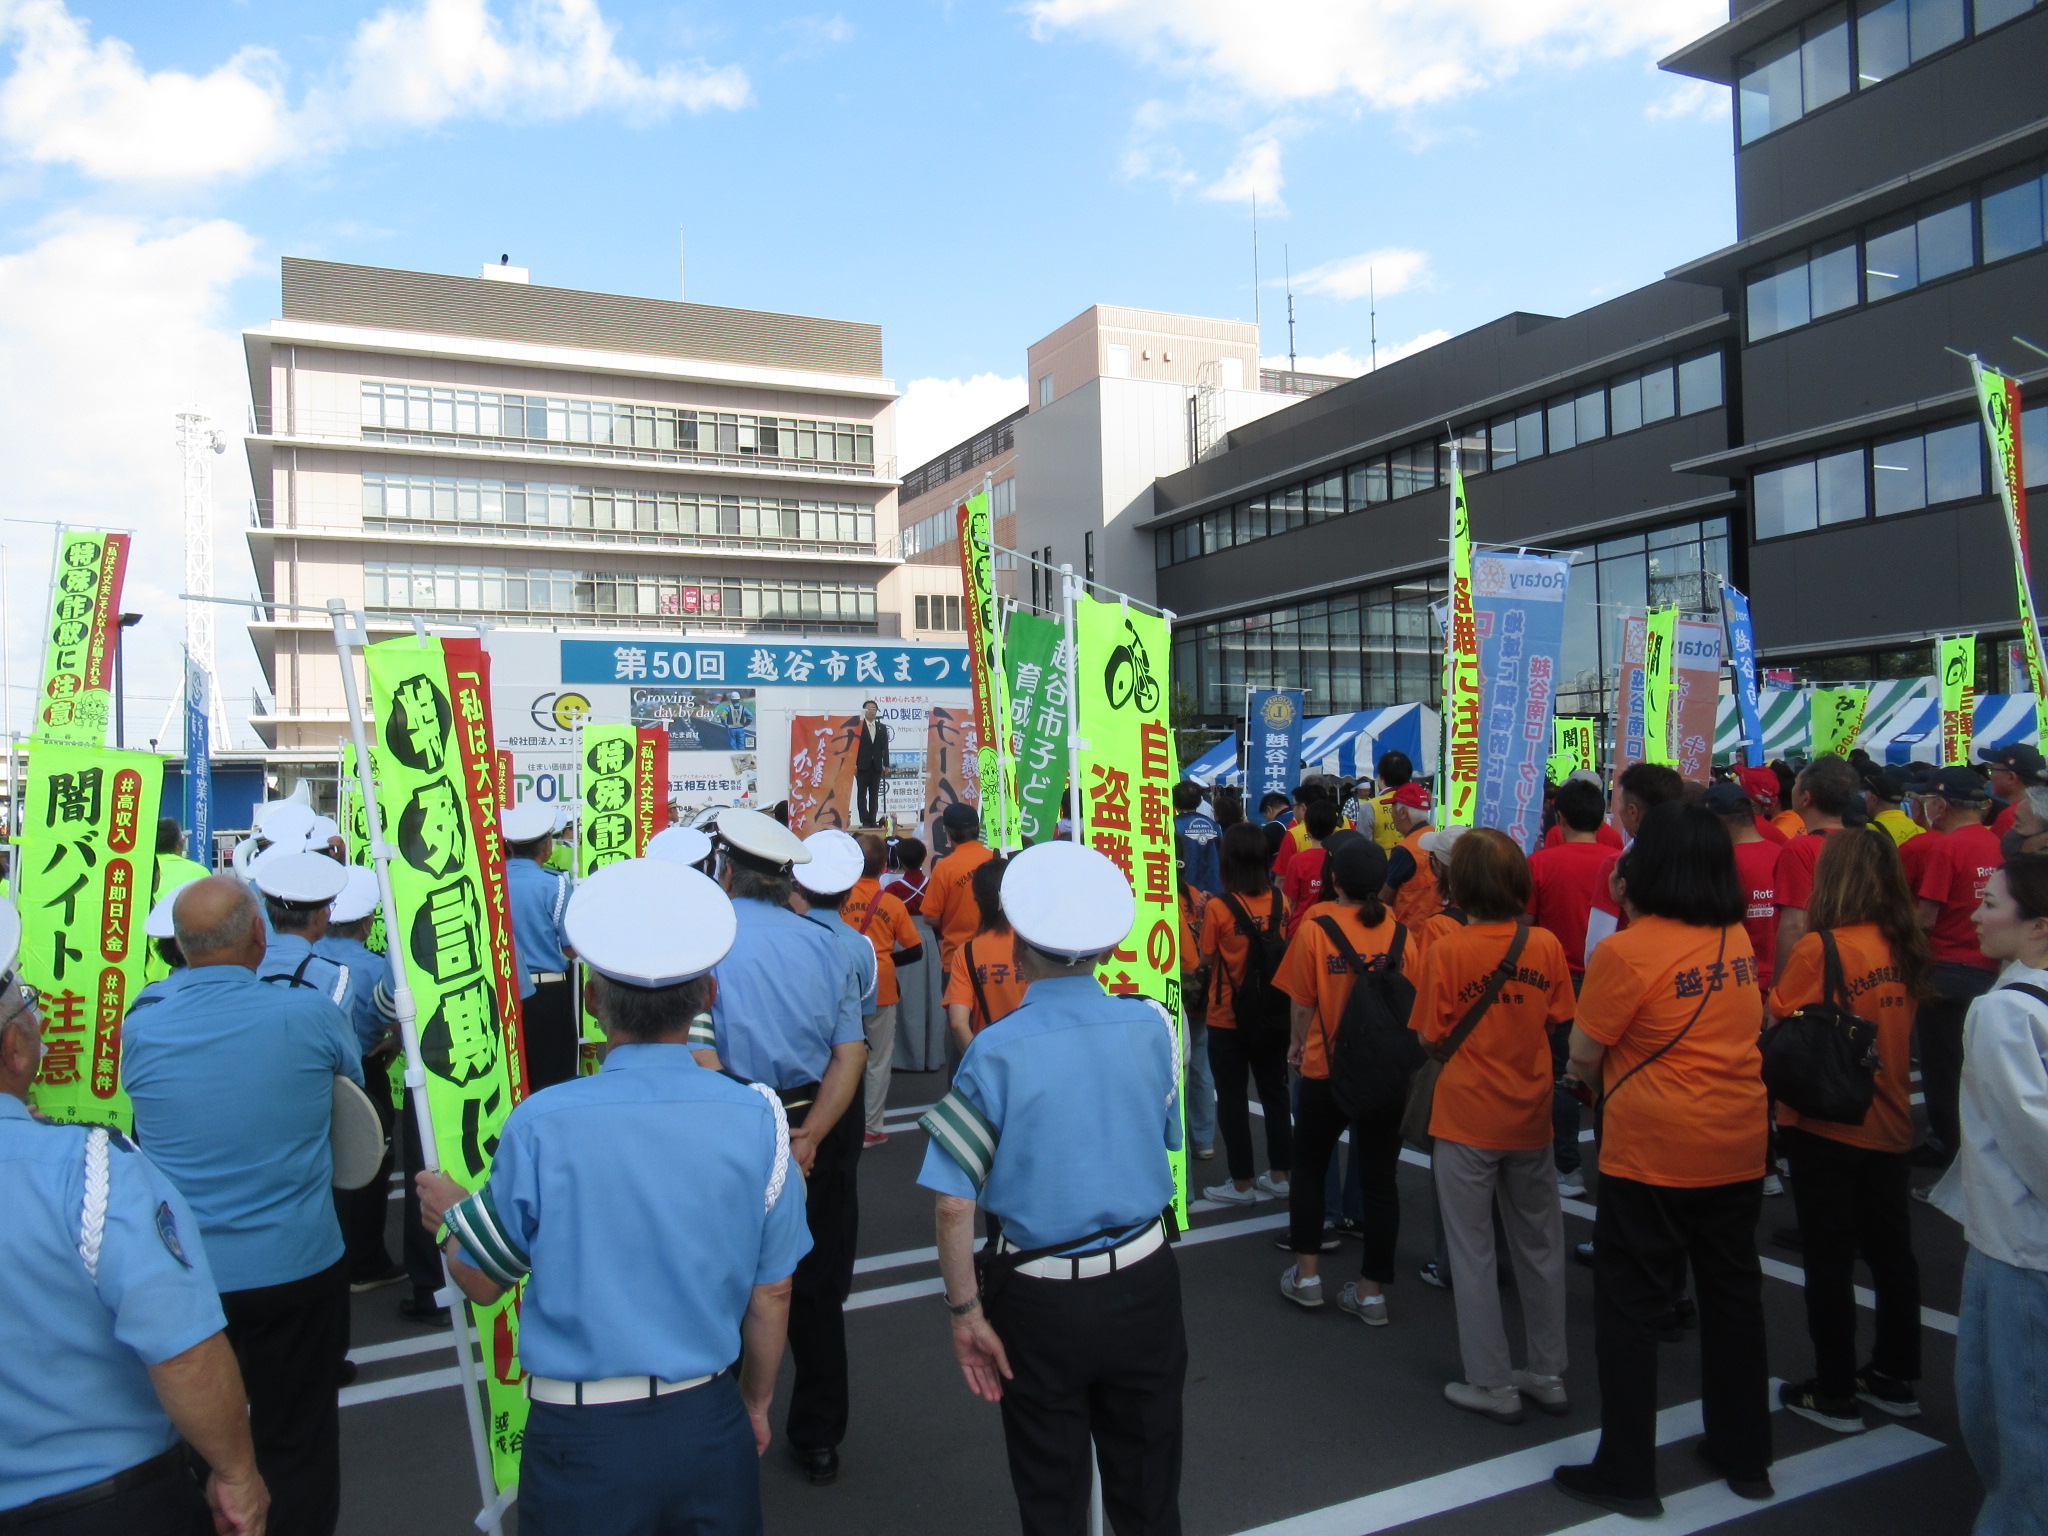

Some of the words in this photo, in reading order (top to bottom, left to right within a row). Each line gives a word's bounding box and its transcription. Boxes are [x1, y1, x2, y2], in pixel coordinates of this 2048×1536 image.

[49, 541, 99, 727] 特殊詐欺に注意
[613, 647, 726, 681] 第50回
[500, 737, 556, 746] 一般社団法人
[633, 689, 696, 709] Growing
[653, 705, 676, 719] day
[678, 705, 694, 721] by
[695, 705, 720, 721] day.
[112, 777, 135, 844] #高収入
[814, 715, 862, 830] チーム
[1139, 718, 1177, 976] 自転車の
[36, 767, 104, 1086] 闇バイト注意
[106, 868, 127, 953] #即日入金
[95, 974, 119, 1092] #ホワイト案件
